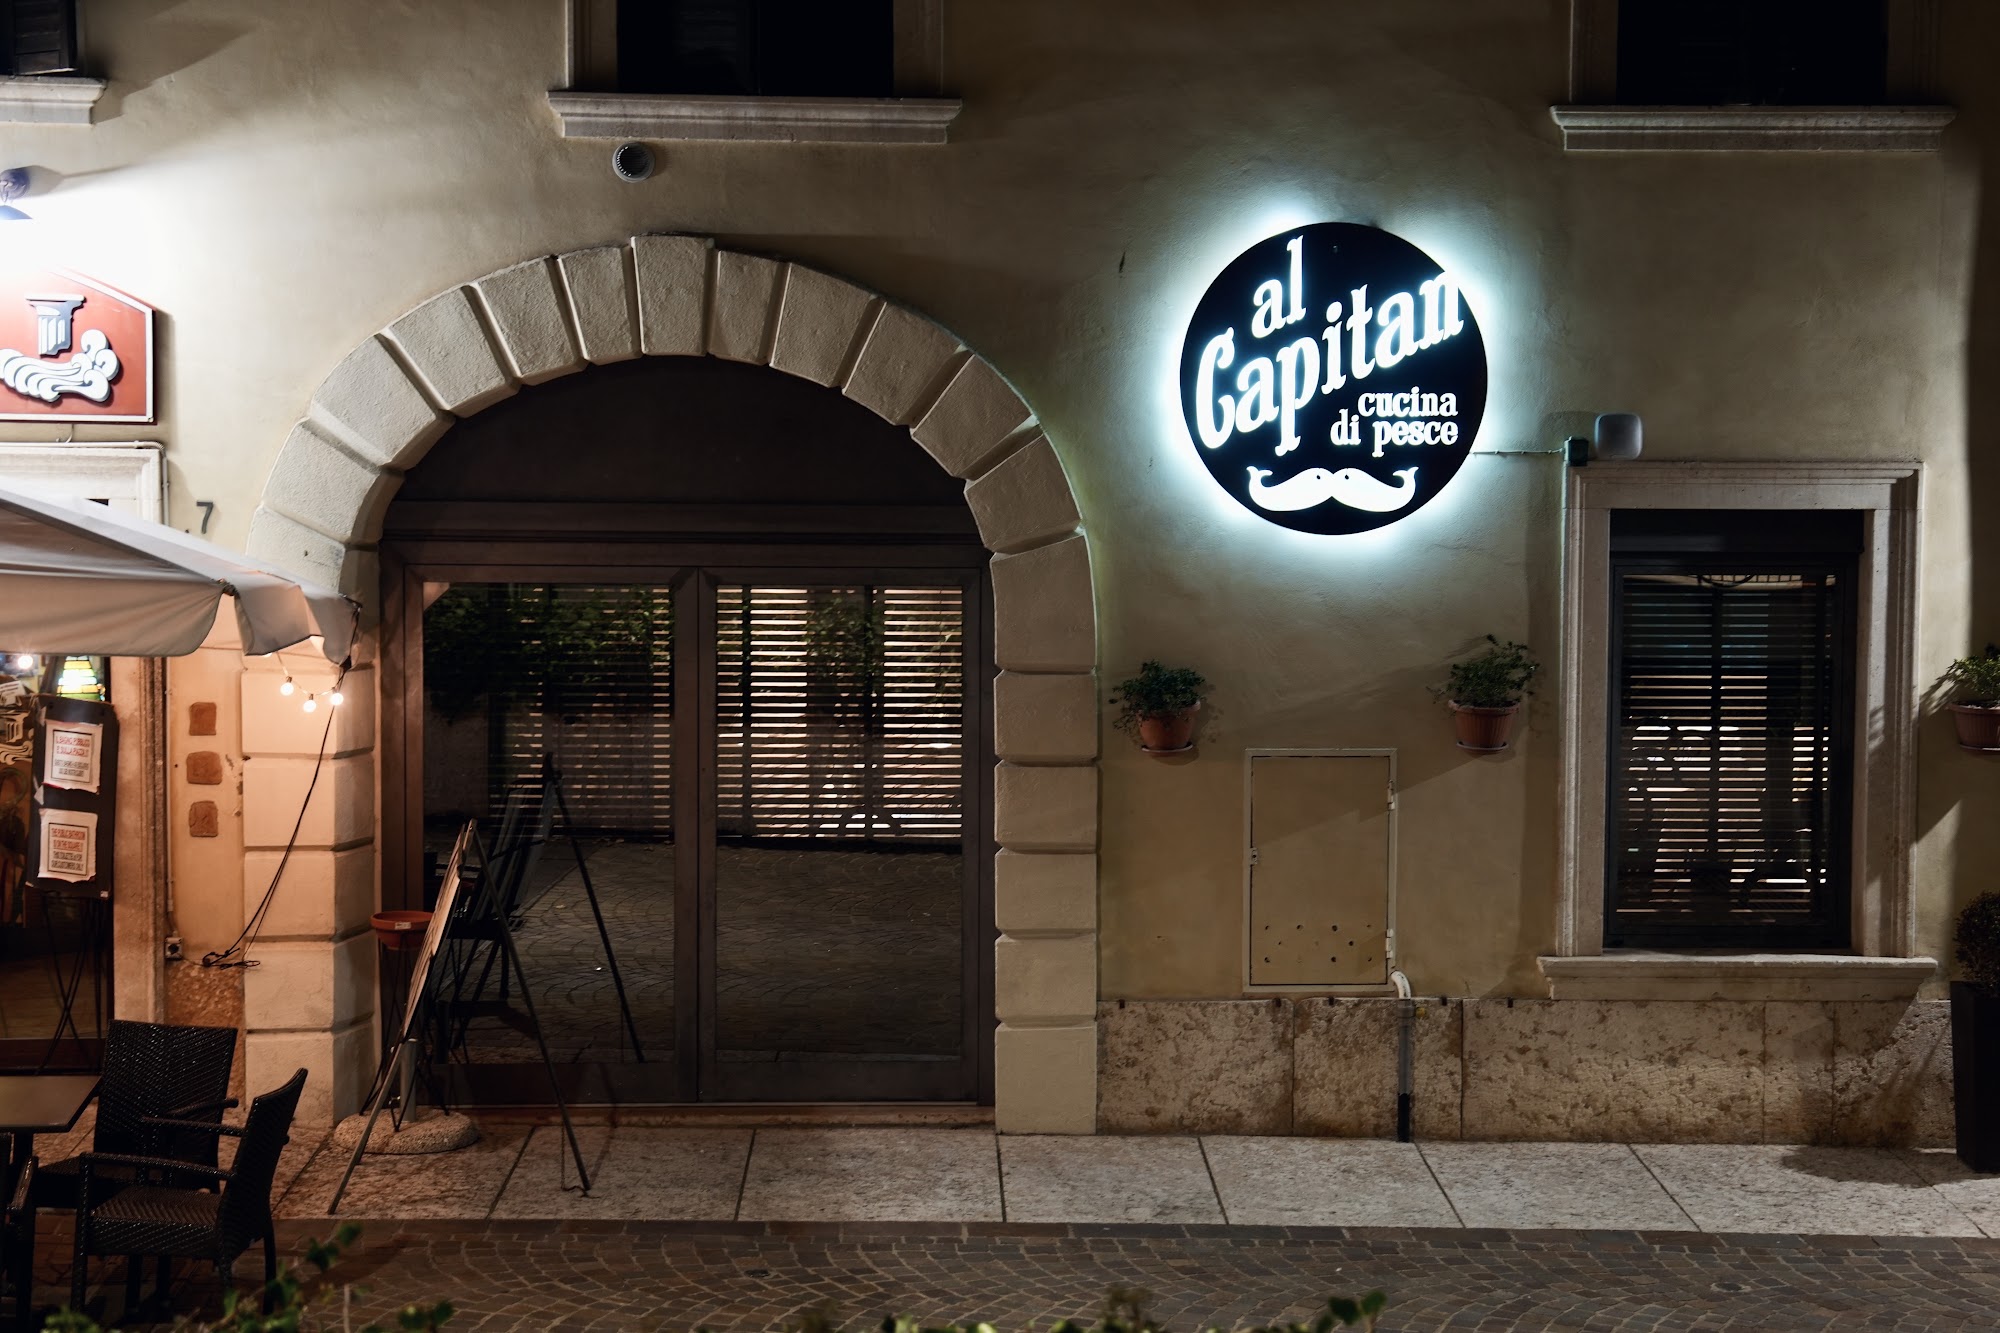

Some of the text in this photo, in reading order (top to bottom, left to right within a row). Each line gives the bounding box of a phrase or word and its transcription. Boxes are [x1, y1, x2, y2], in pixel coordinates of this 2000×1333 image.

[1251, 234, 1307, 338] al
[1196, 271, 1464, 457] Capitan
[1357, 386, 1458, 417] cucina
[1330, 408, 1459, 458] di pesce
[196, 501, 215, 535] 7
